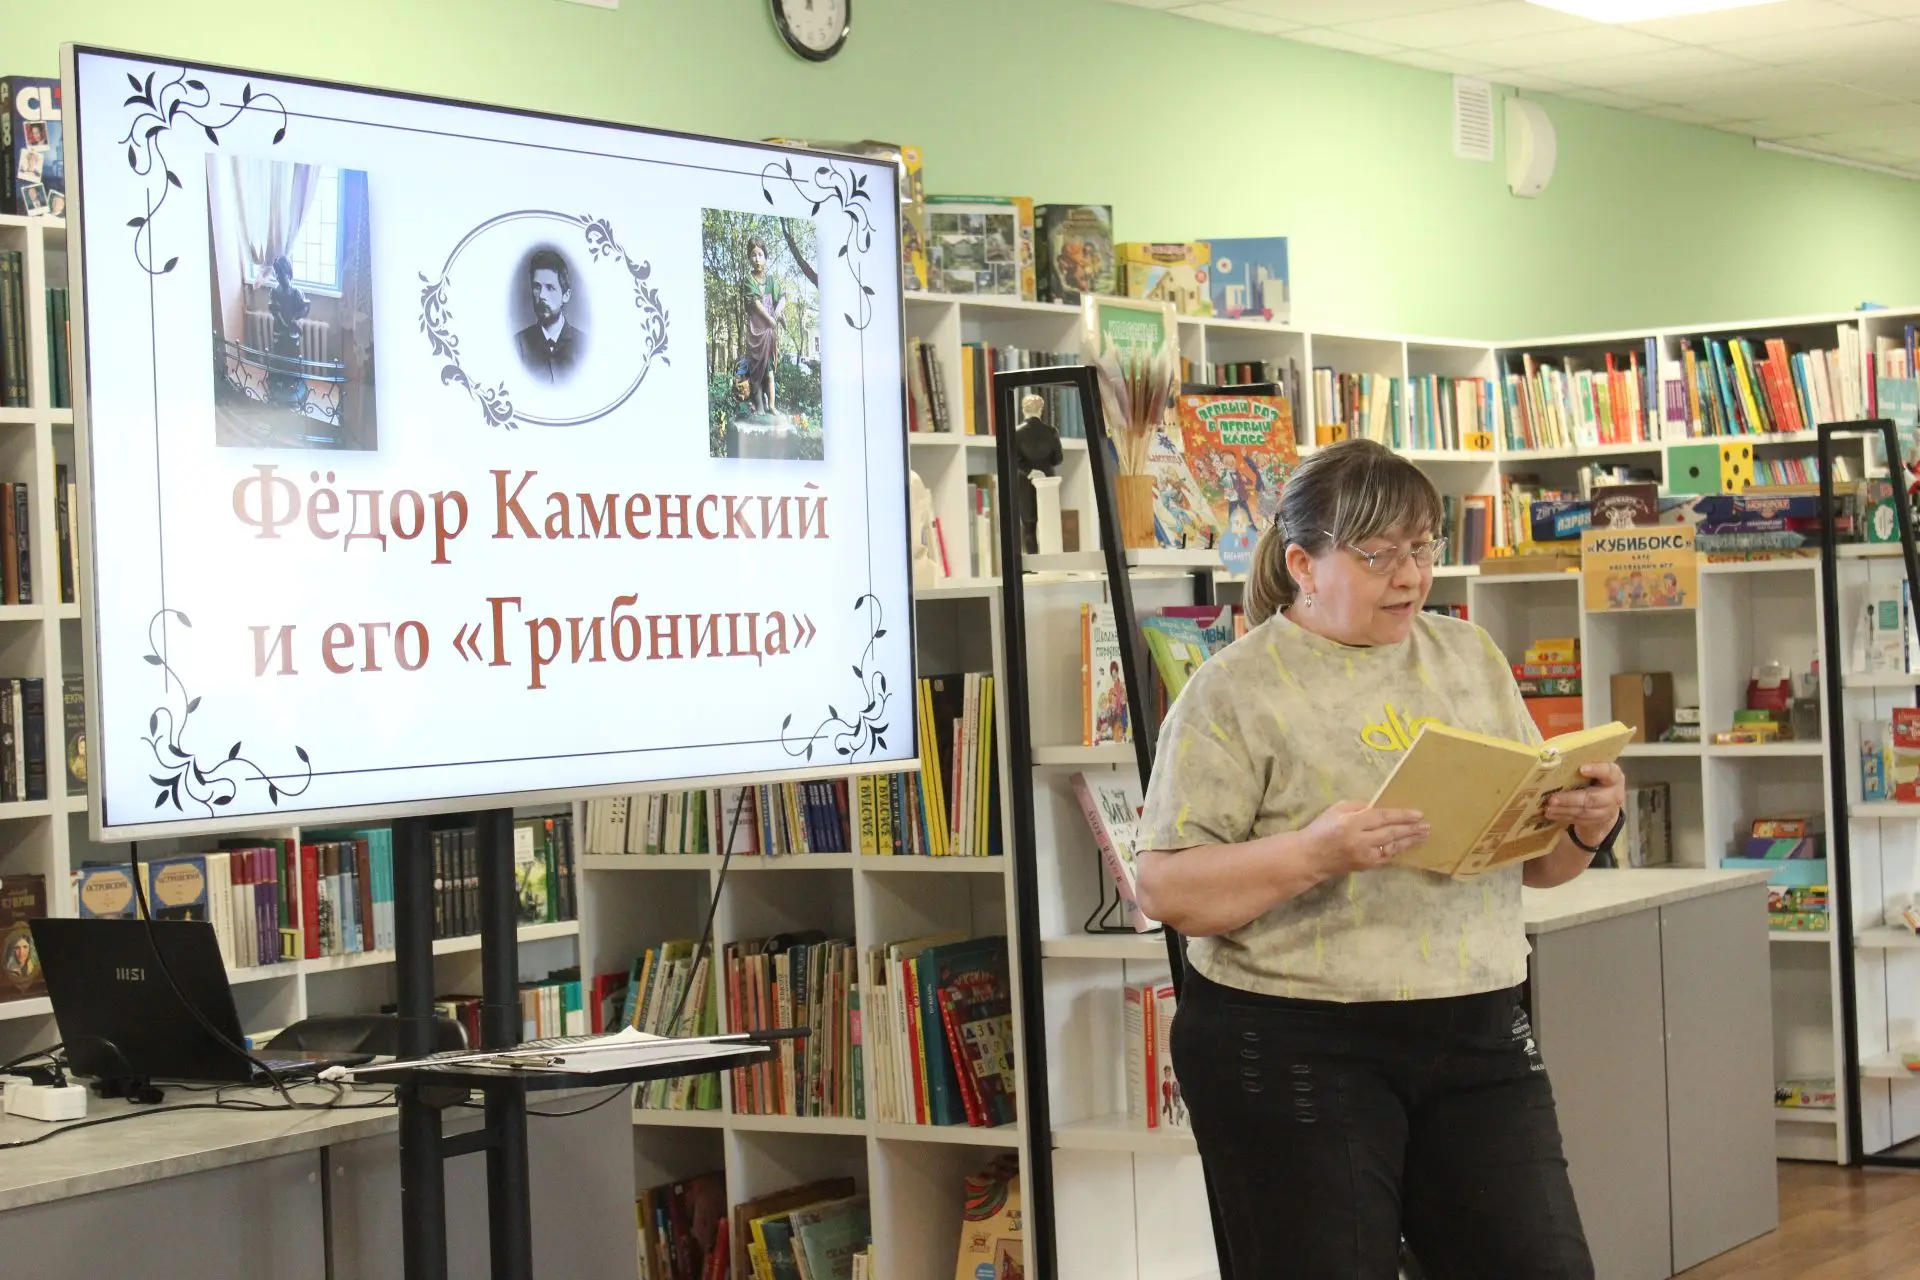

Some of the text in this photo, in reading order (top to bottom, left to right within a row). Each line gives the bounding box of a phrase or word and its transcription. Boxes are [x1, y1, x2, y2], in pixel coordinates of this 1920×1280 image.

[1222, 433, 1266, 445] КЛАСС
[1474, 435, 1490, 450] Ф
[232, 463, 830, 565] Фёдор Каменский
[1587, 535, 1692, 554] «КУБИБОКС»
[247, 592, 818, 690] и его «Грибница»
